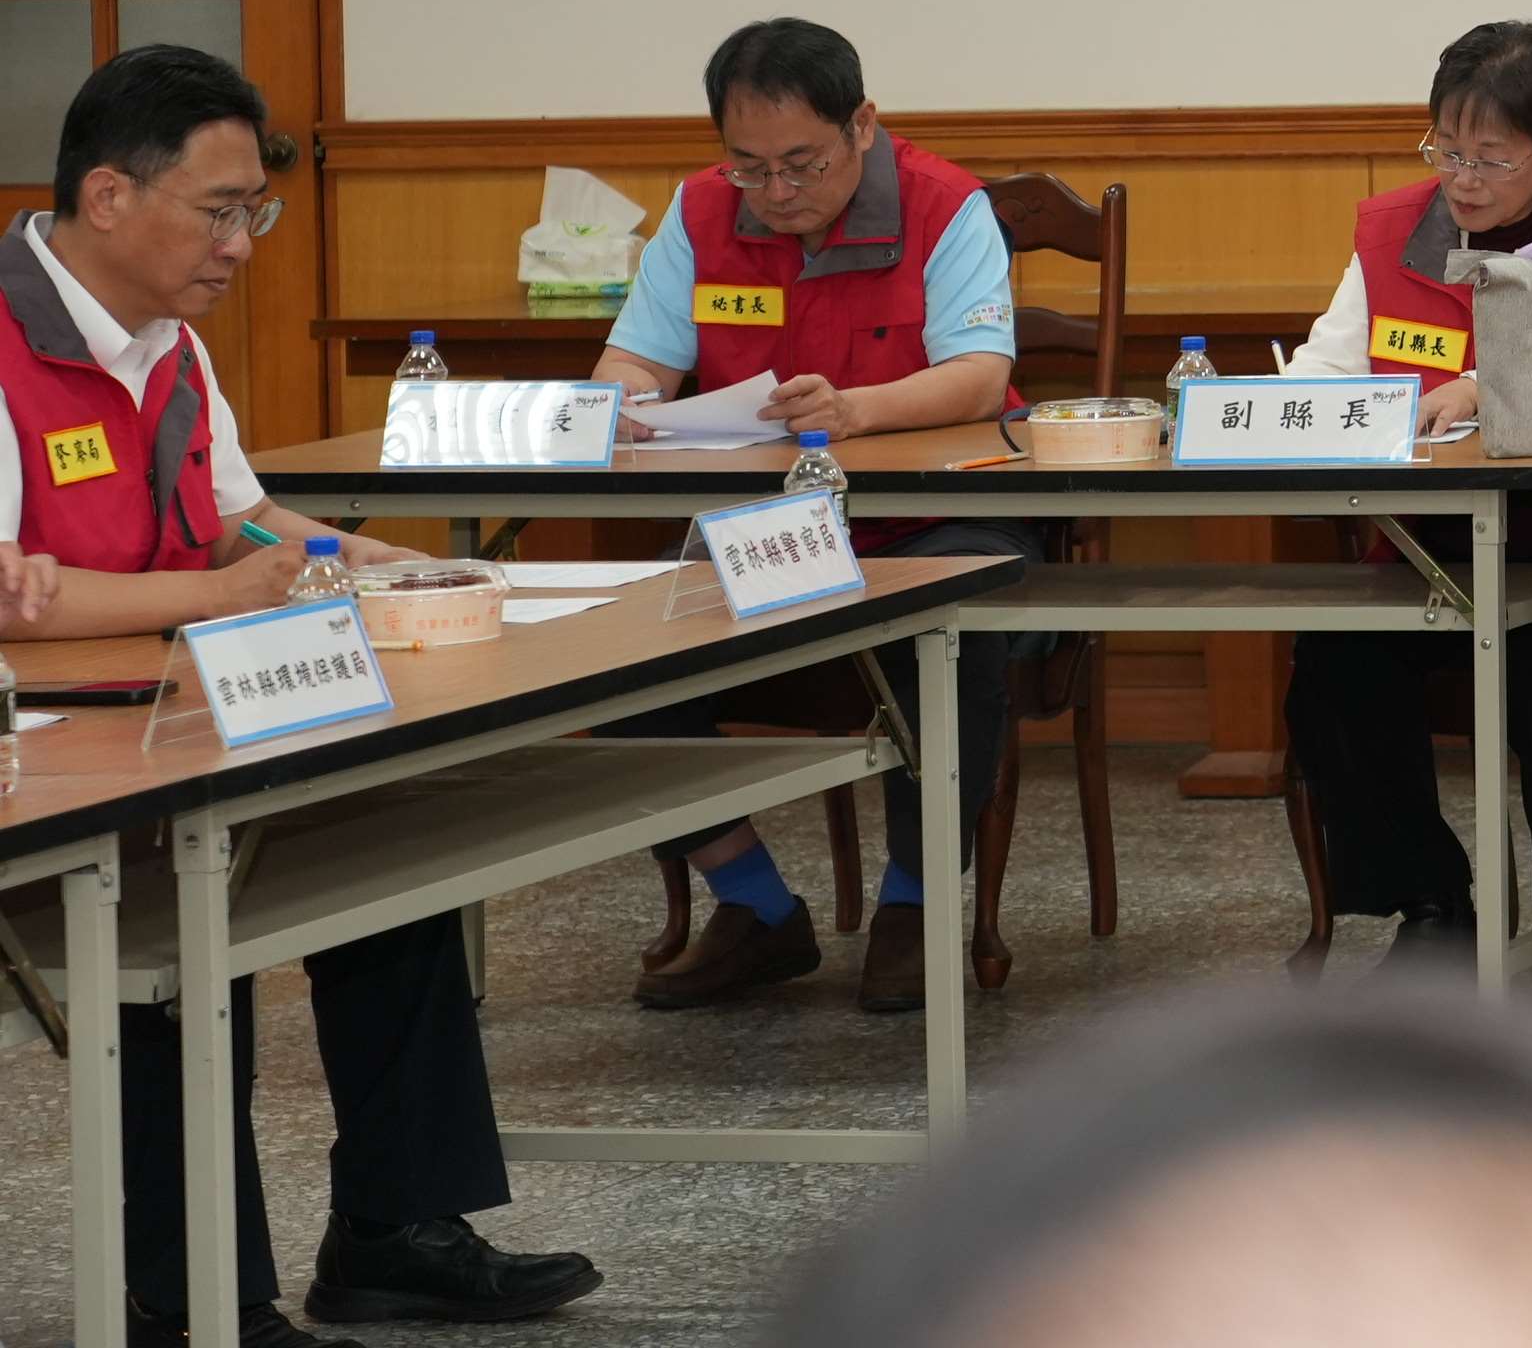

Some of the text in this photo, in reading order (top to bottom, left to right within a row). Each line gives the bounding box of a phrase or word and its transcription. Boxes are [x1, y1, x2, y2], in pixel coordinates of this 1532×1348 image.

[1387, 330, 1447, 357] 副縣長
[1221, 398, 1371, 430] 副縣長
[724, 522, 837, 577] 雲林縣警察局
[216, 650, 368, 707] 雲林縣環境保護局
